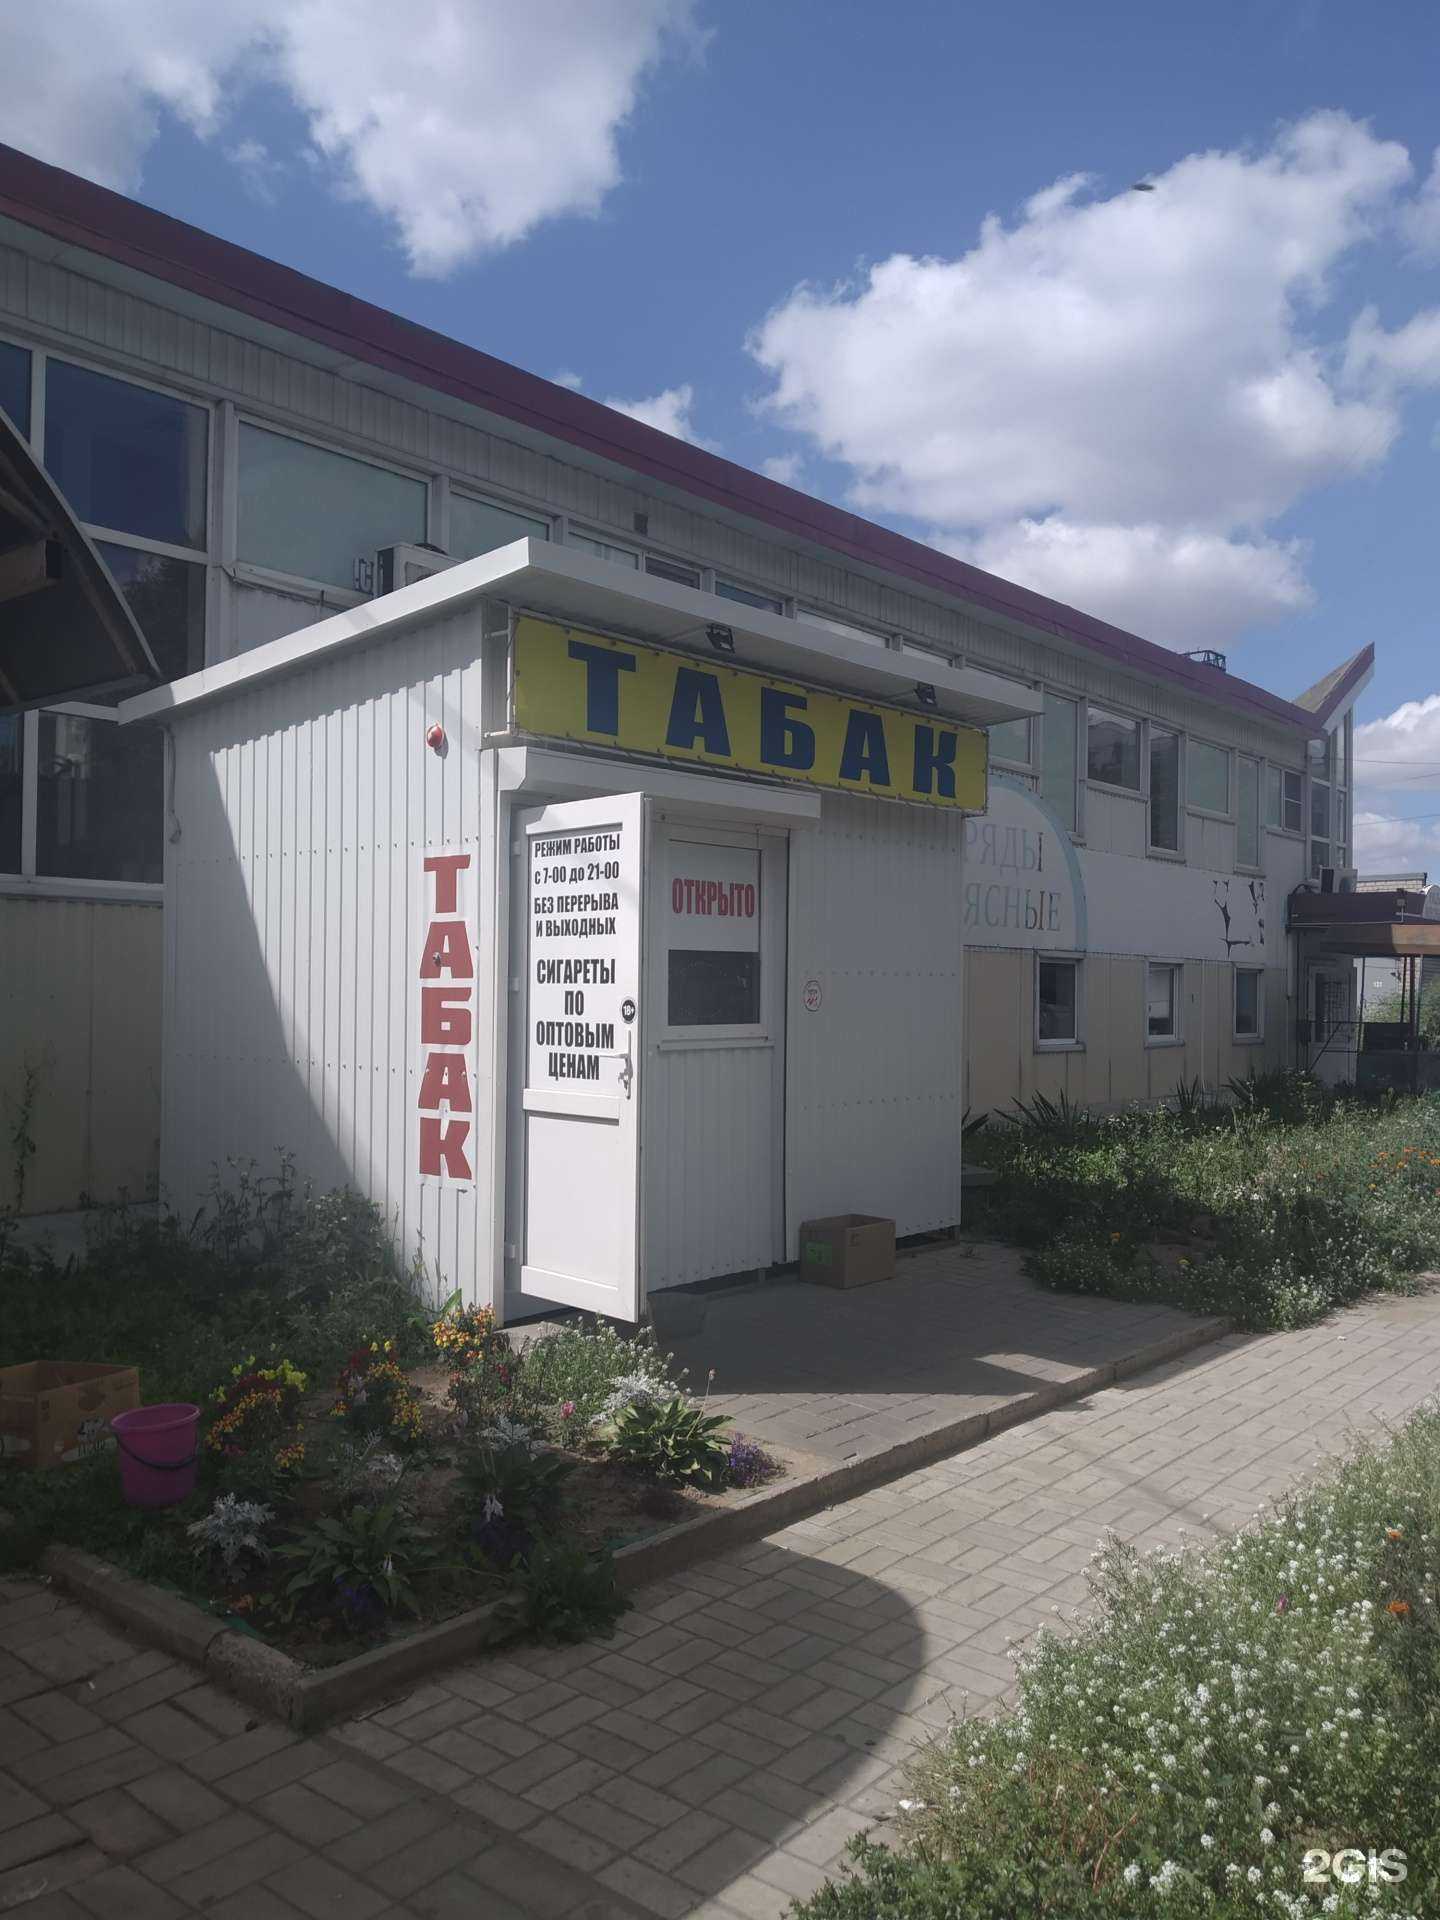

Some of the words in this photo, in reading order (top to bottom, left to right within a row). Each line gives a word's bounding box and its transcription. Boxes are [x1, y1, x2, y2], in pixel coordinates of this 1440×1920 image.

[567, 640, 958, 799] ТАБАК
[535, 839, 572, 858] РЕЖИМ
[574, 833, 620, 854] РАБОТЫ
[963, 821, 1045, 877] РЯДЫ
[534, 871, 541, 885] с
[543, 866, 567, 884] 7-00
[569, 867, 585, 884] до
[587, 861, 619, 881] 21-00
[534, 896, 554, 914] БЕЗ
[557, 892, 619, 913] ПЕРЕРЫВА
[671, 878, 755, 918] ОТКРЫТО
[963, 882, 1063, 932] ЯСНЫЕ
[536, 920, 543, 937] И
[545, 917, 616, 938] ВЫХОДНЫХ
[536, 958, 616, 984] СИГАРЕТЫ
[418, 854, 474, 1180] ТАБАК
[564, 990, 584, 1016] ПО
[536, 1020, 614, 1049] ОПТОВЫМ
[548, 1052, 600, 1081] ЦЕНАМ
